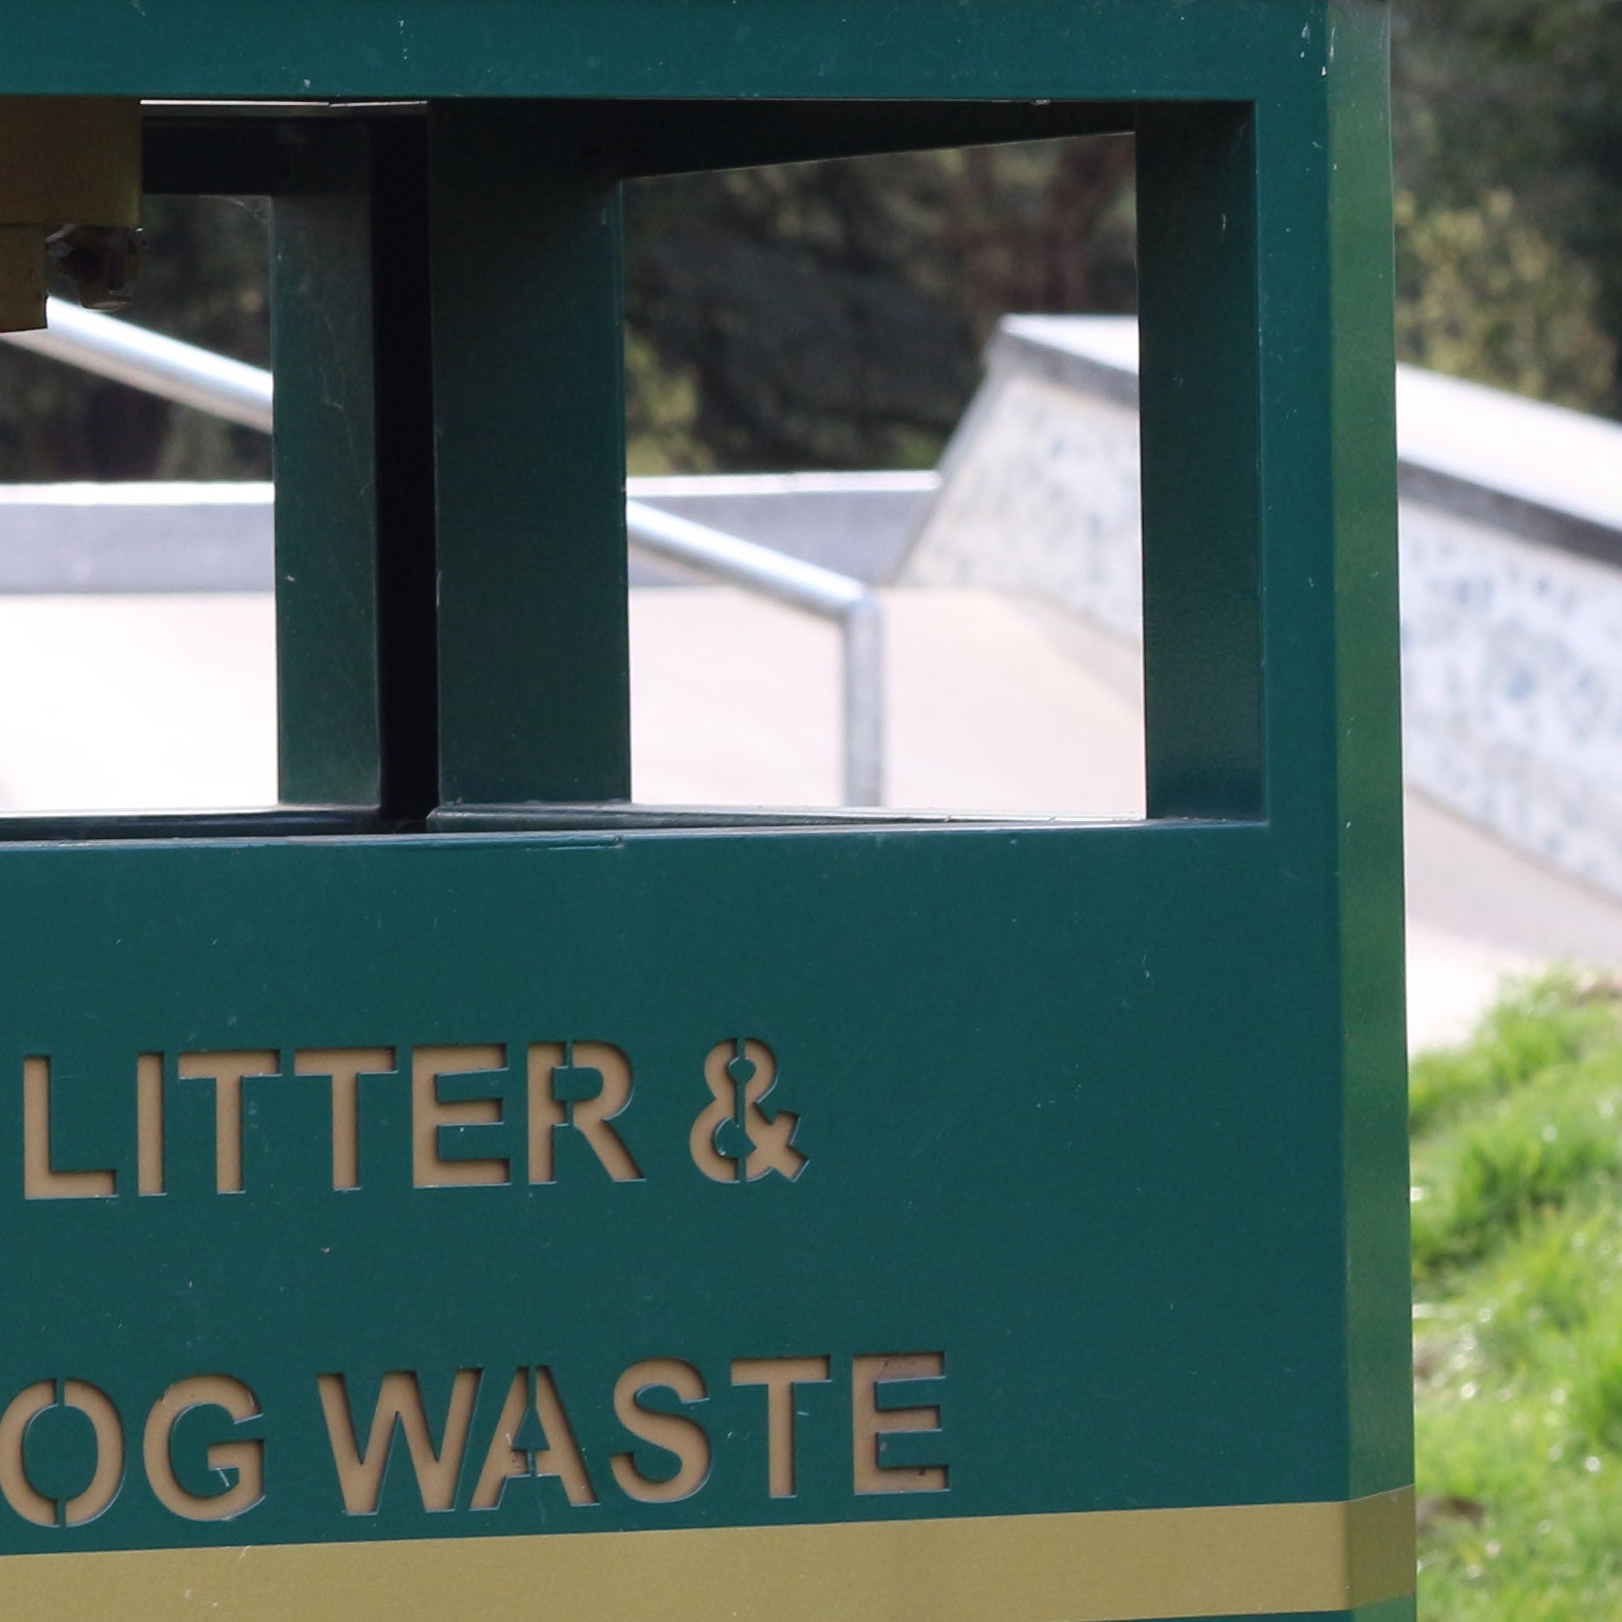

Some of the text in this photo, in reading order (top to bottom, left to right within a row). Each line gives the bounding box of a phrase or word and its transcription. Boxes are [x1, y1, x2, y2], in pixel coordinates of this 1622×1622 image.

[22, 1037, 811, 1200] LITTER &
[316, 1351, 951, 1517] WASTE
